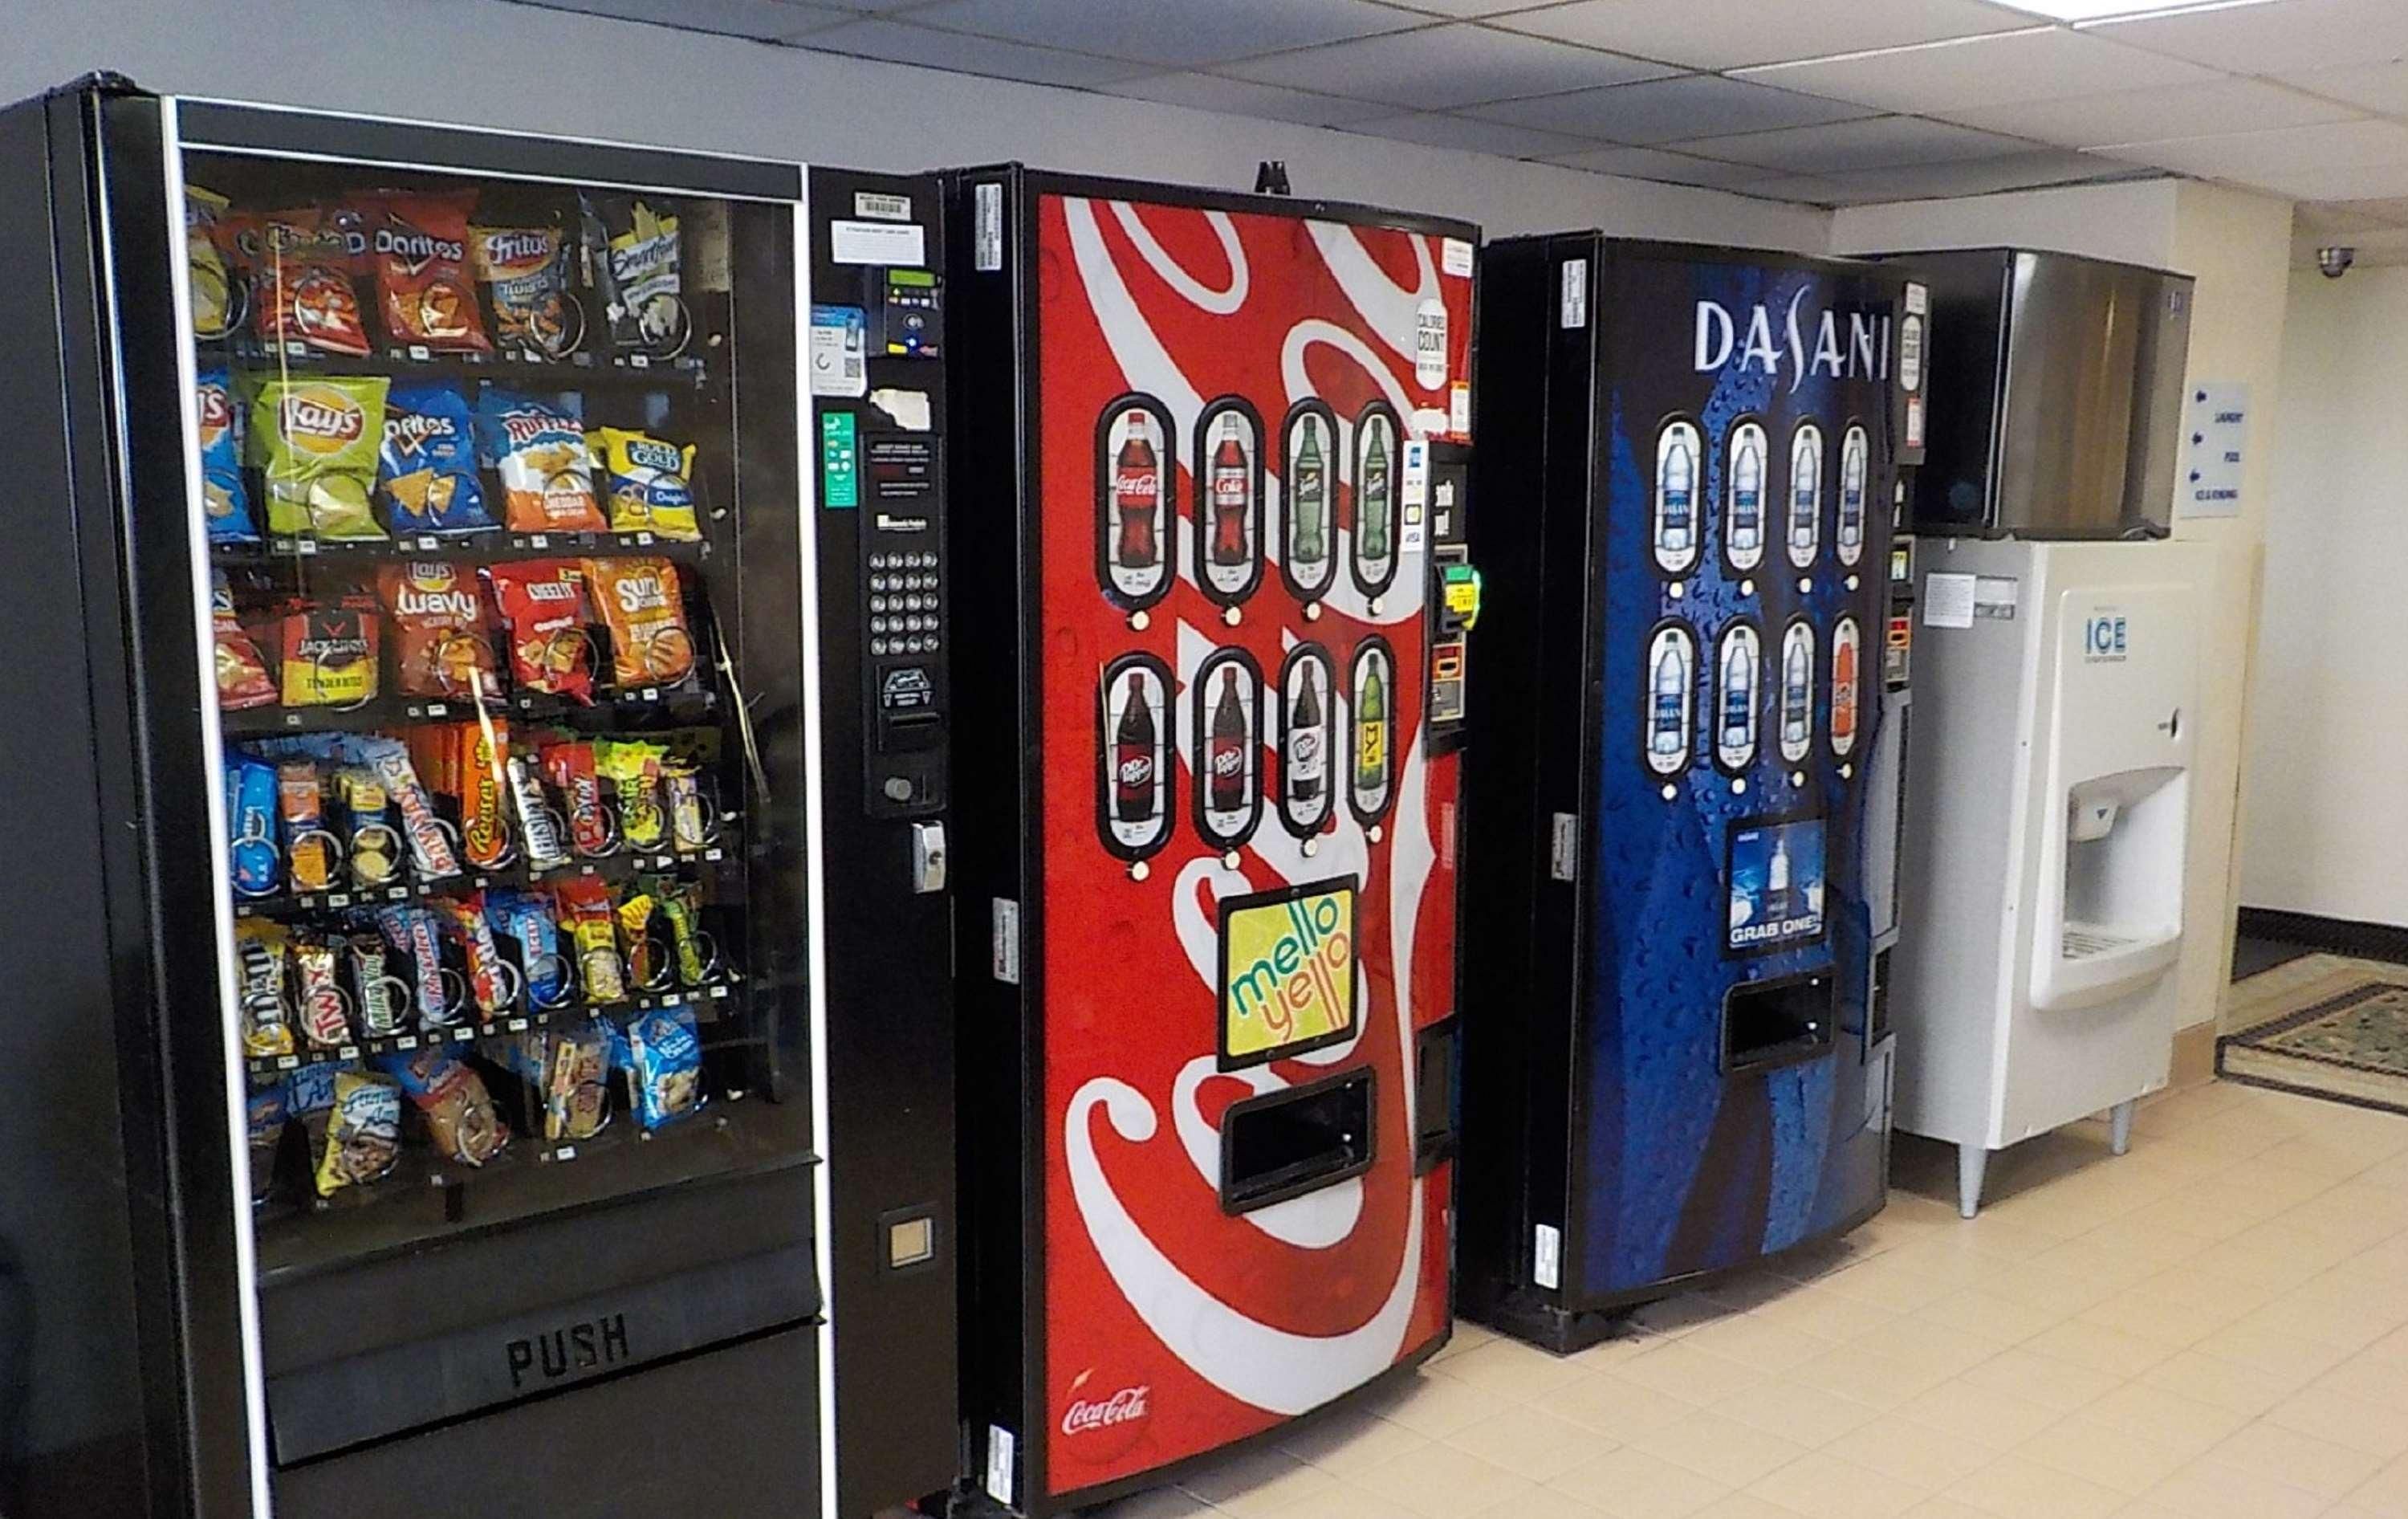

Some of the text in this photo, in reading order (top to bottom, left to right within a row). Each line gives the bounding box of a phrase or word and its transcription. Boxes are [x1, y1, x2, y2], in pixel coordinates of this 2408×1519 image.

[375, 228, 463, 261] Doritos
[1694, 284, 1890, 394] DASANI
[2085, 617, 2126, 654] ICE
[1230, 897, 1338, 1016] mello
[1731, 923, 1780, 943] GRAB
[308, 968, 346, 1037] TWX
[1261, 931, 1350, 1041] yello
[506, 1313, 628, 1387] PUSH
[1061, 1384, 1151, 1436] Coca-Cola
